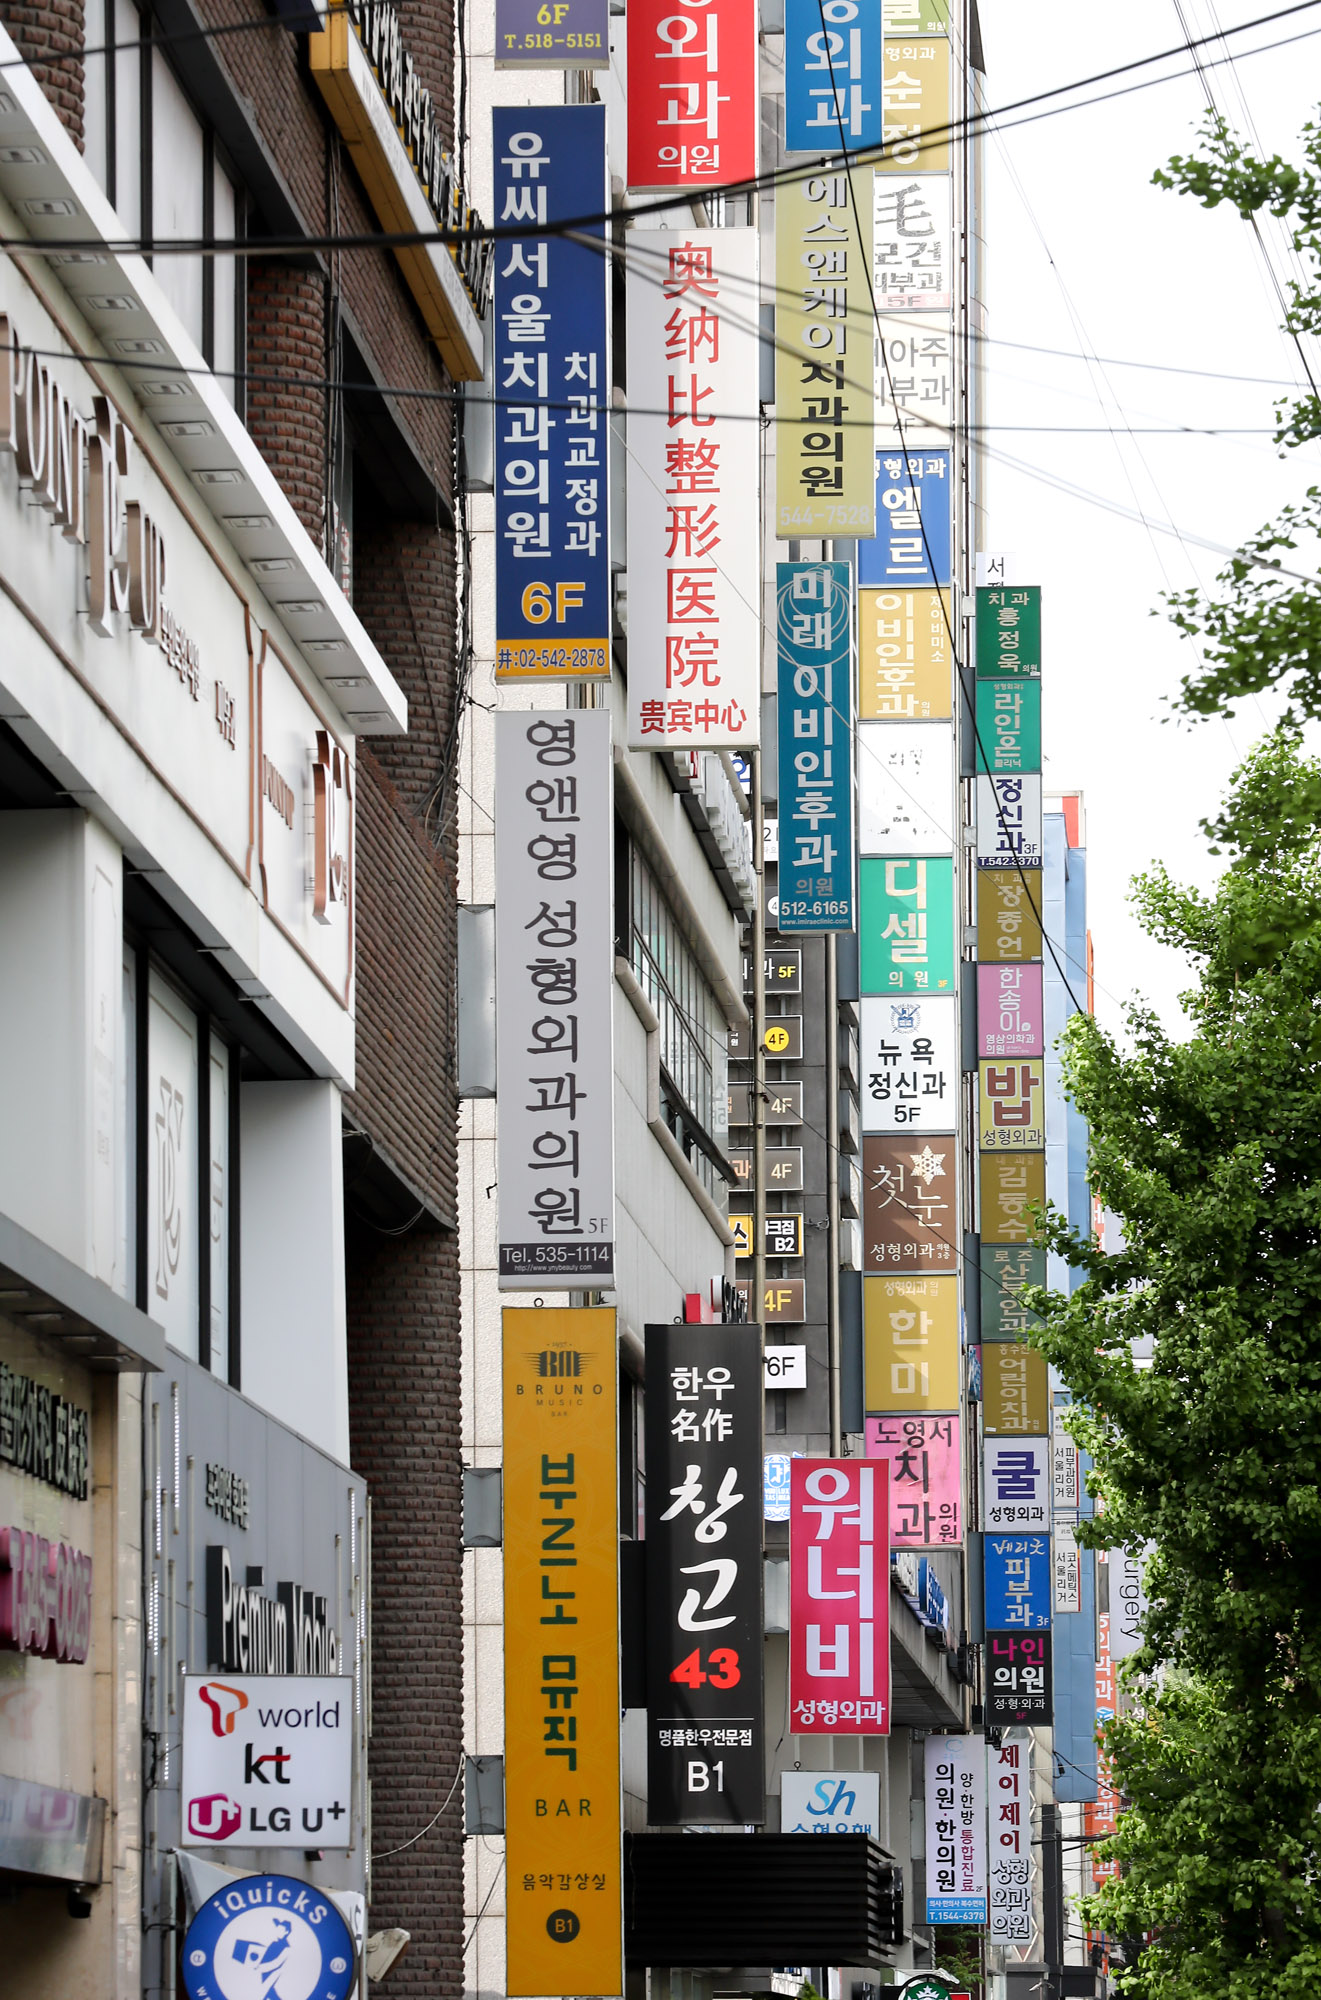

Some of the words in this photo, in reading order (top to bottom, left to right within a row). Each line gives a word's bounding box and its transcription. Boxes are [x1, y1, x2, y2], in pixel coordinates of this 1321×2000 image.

[536, 4, 569, 25] 6F
[504, 34, 602, 49] T.518-5151
[657, 145, 720, 174] 의원
[875, 183, 936, 237] 毛
[564, 352, 602, 557] 치과교정과
[663, 241, 722, 690] 奥纳比整形医院
[780, 505, 870, 527] 544-7528
[882, 486, 928, 574] 엘르
[521, 582, 585, 624] 6F
[988, 592, 1030, 606] 치과
[875, 594, 920, 716] 이비인후과
[639, 698, 747, 735] 贵宾中心
[792, 569, 838, 873] 미래이비인후과
[995, 778, 1026, 854] 정신과
[1024, 843, 1038, 854] 3F
[795, 877, 833, 897] 의원
[781, 901, 849, 915] 512-6165
[881, 860, 928, 963] 디셀
[778, 966, 796, 978] 5F
[889, 970, 929, 989] 의원
[998, 967, 1023, 1032] 한송이
[768, 1033, 785, 1045] 4F
[877, 1037, 935, 1067] 뉴욕
[985, 1034, 1035, 1044] 영상의학과
[985, 1045, 1006, 1055] 의원
[868, 1071, 947, 1100] 정신과
[986, 1065, 1040, 1127] 밥
[771, 1098, 793, 1113] 4F
[893, 1104, 921, 1123] 5F
[983, 1129, 1042, 1146] 성형외과
[771, 1163, 792, 1179] 4F
[587, 1218, 609, 1234] 5F
[503, 1247, 531, 1263] Tel.
[535, 1246, 610, 1262] 535-1114
[775, 1237, 795, 1251] B2
[870, 1243, 935, 1263] 성형외과
[993, 1250, 1033, 1263] 로즈
[764, 1289, 792, 1312] 4F
[884, 1281, 927, 1297] 성형외과
[889, 1309, 933, 1397] 한미
[767, 1357, 795, 1376] 6F
[516, 1384, 603, 1395] BRUNO
[671, 1367, 735, 1401] 한우
[671, 1408, 734, 1442] 名作
[875, 1420, 952, 1449] 노영서
[992, 1451, 1040, 1499] 쿨
[894, 1450, 936, 1544] 치과
[989, 1506, 1045, 1522] 성형외과
[659, 1464, 744, 1633] 창고
[802, 1467, 874, 1697] 워너비
[1005, 1557, 1034, 1627] 피부과
[1036, 1616, 1049, 1627] 3F
[992, 1638, 1045, 1665] 나인
[669, 1648, 741, 1690] 43
[993, 1666, 1045, 1694] 의원
[258, 1701, 340, 1728] world
[793, 1700, 886, 1726] 성형외과
[658, 1729, 752, 1747] 명품한우전문점
[244, 1743, 291, 1784] kt
[687, 1761, 725, 1792] B1
[535, 1798, 592, 1818] BAR
[806, 1779, 856, 1816] Sh
[998, 1745, 1021, 1854] 제이제이
[250, 1807, 291, 1831] LG
[522, 1872, 606, 1891] 음악감상실
[992, 1859, 1029, 1886] 성형
[213, 1881, 328, 1924] iQuickS
[992, 1887, 1030, 1913] 외과
[555, 1918, 573, 1934] B1
[929, 1911, 985, 1921] T.1544-6378
[993, 1914, 1030, 1940] 의원
